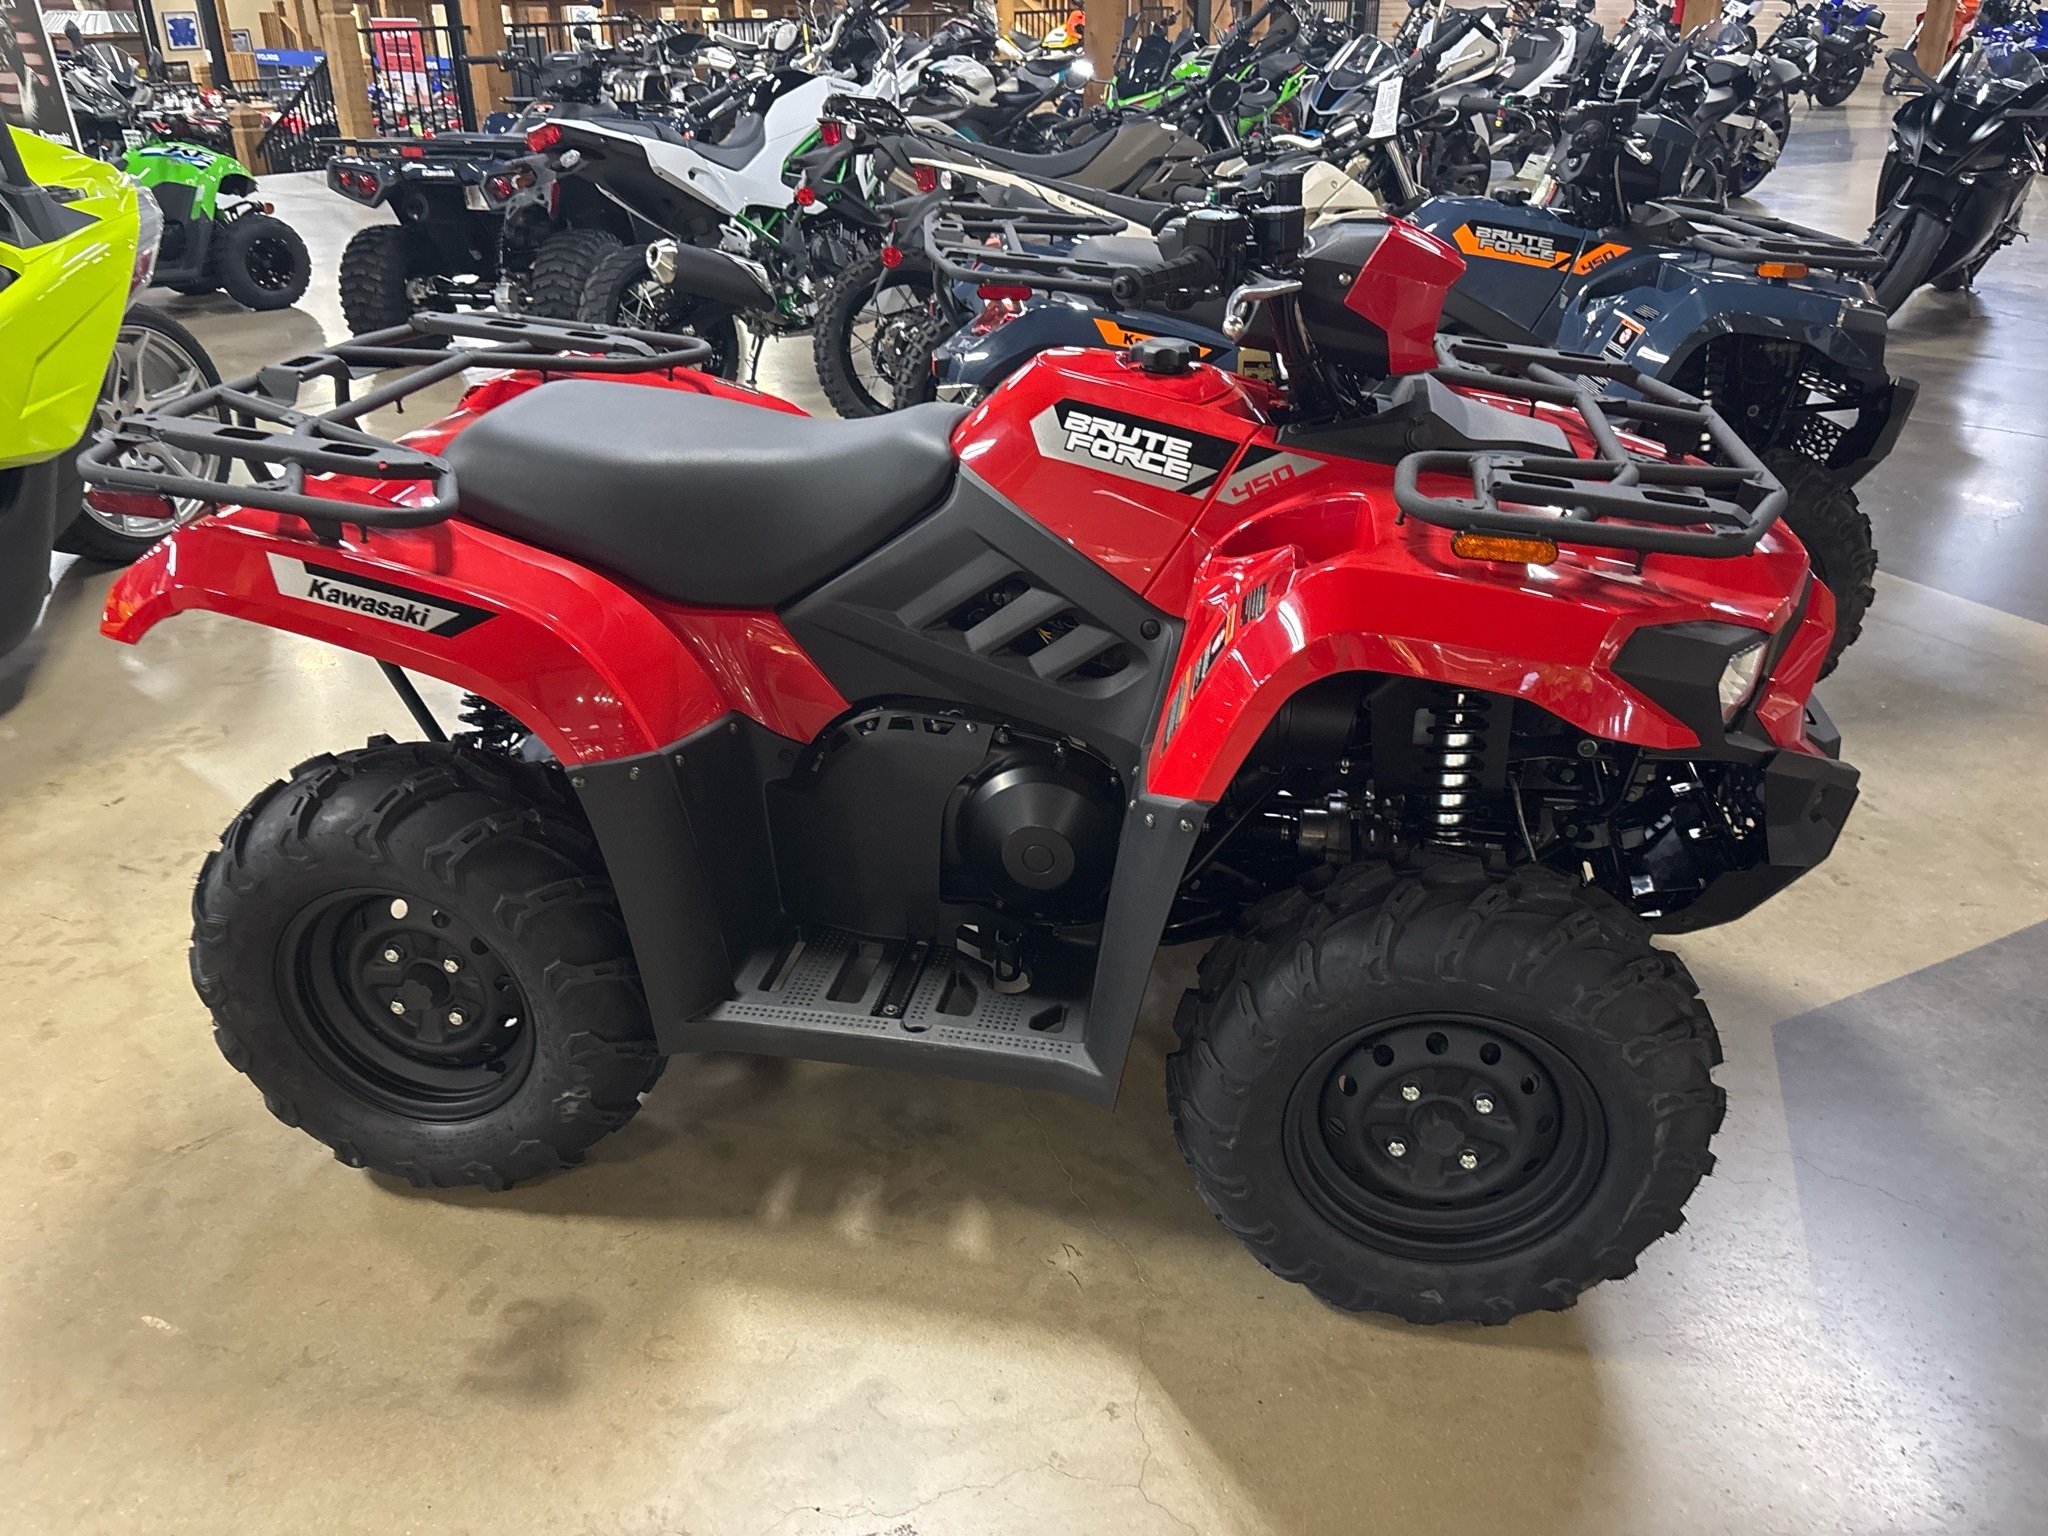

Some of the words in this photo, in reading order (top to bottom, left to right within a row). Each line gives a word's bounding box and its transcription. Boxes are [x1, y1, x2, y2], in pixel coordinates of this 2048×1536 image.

[1475, 226, 1555, 248] BRUTE
[1478, 238, 1557, 262] FORCE
[1580, 250, 1616, 271] 450
[1064, 410, 1193, 461] BRUTE
[1065, 430, 1193, 483] FORCE
[1231, 464, 1296, 498] 450
[307, 578, 431, 627] Kawasaki
